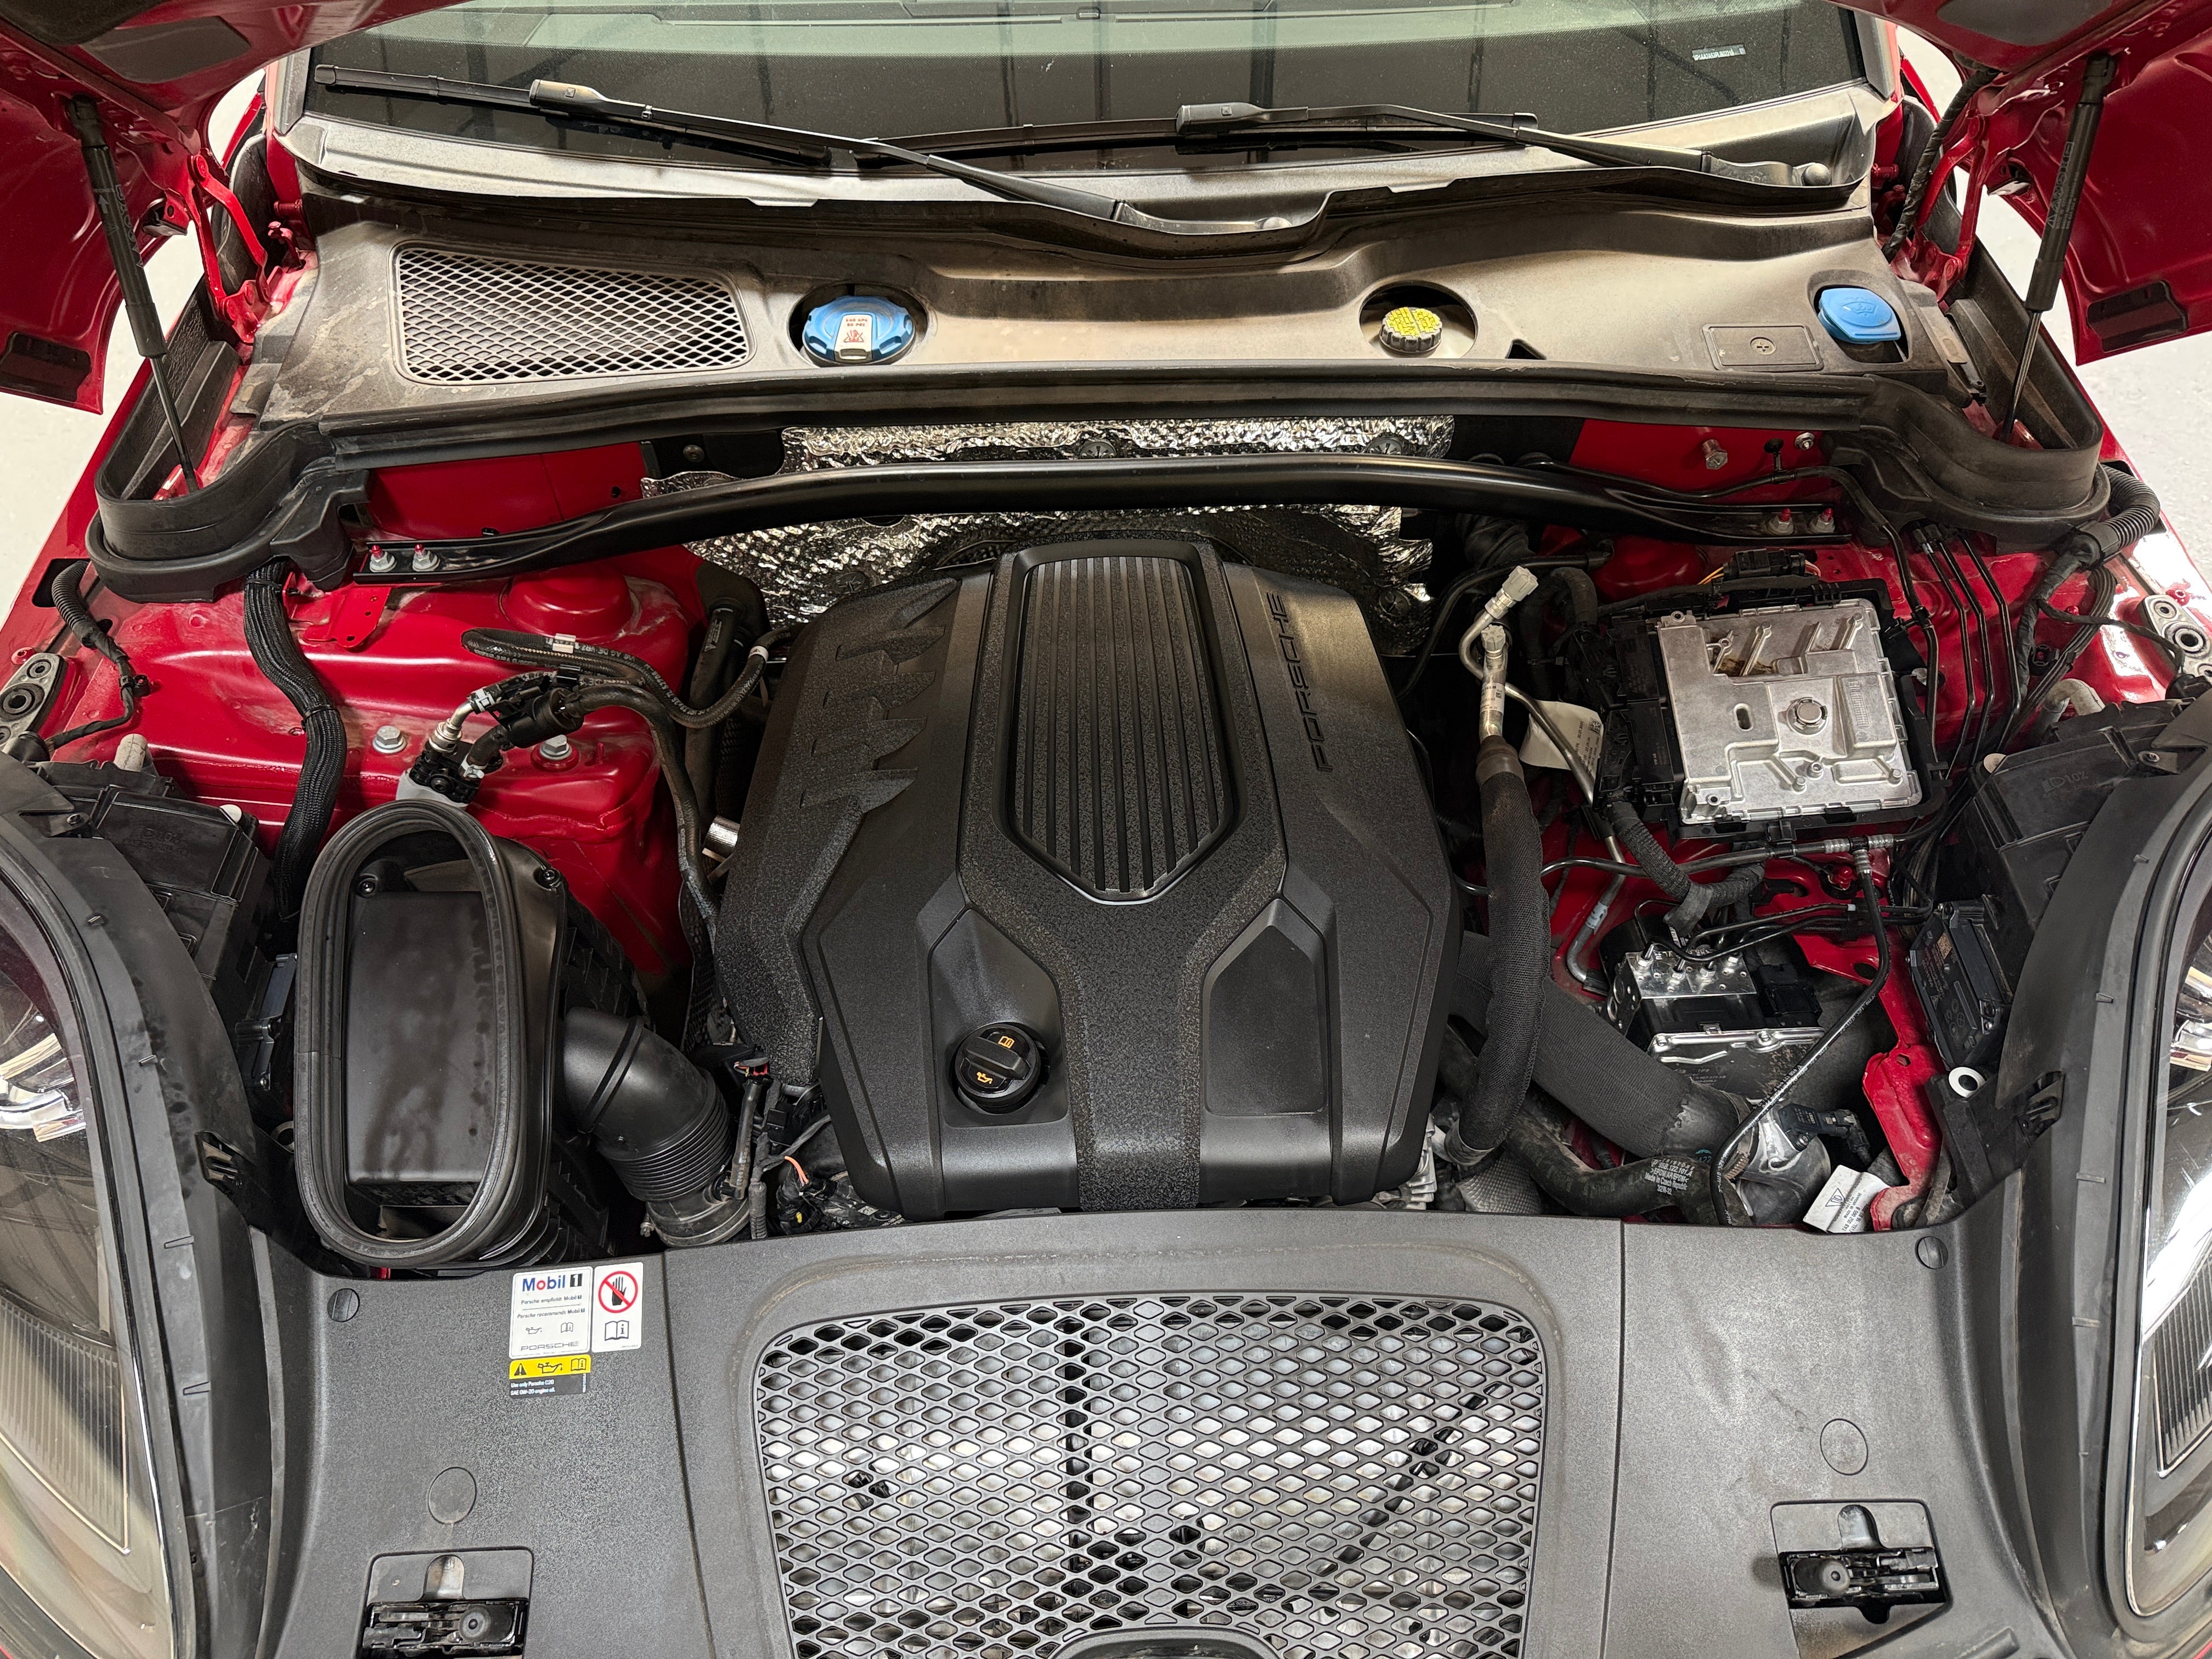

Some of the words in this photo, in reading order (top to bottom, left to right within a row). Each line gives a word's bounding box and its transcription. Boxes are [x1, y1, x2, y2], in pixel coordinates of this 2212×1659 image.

[1266, 592, 1333, 772] PORSCHE
[522, 1274, 566, 1291] Mobil
[569, 1273, 583, 1288] 1
[521, 1341, 579, 1351] PORSCHE
